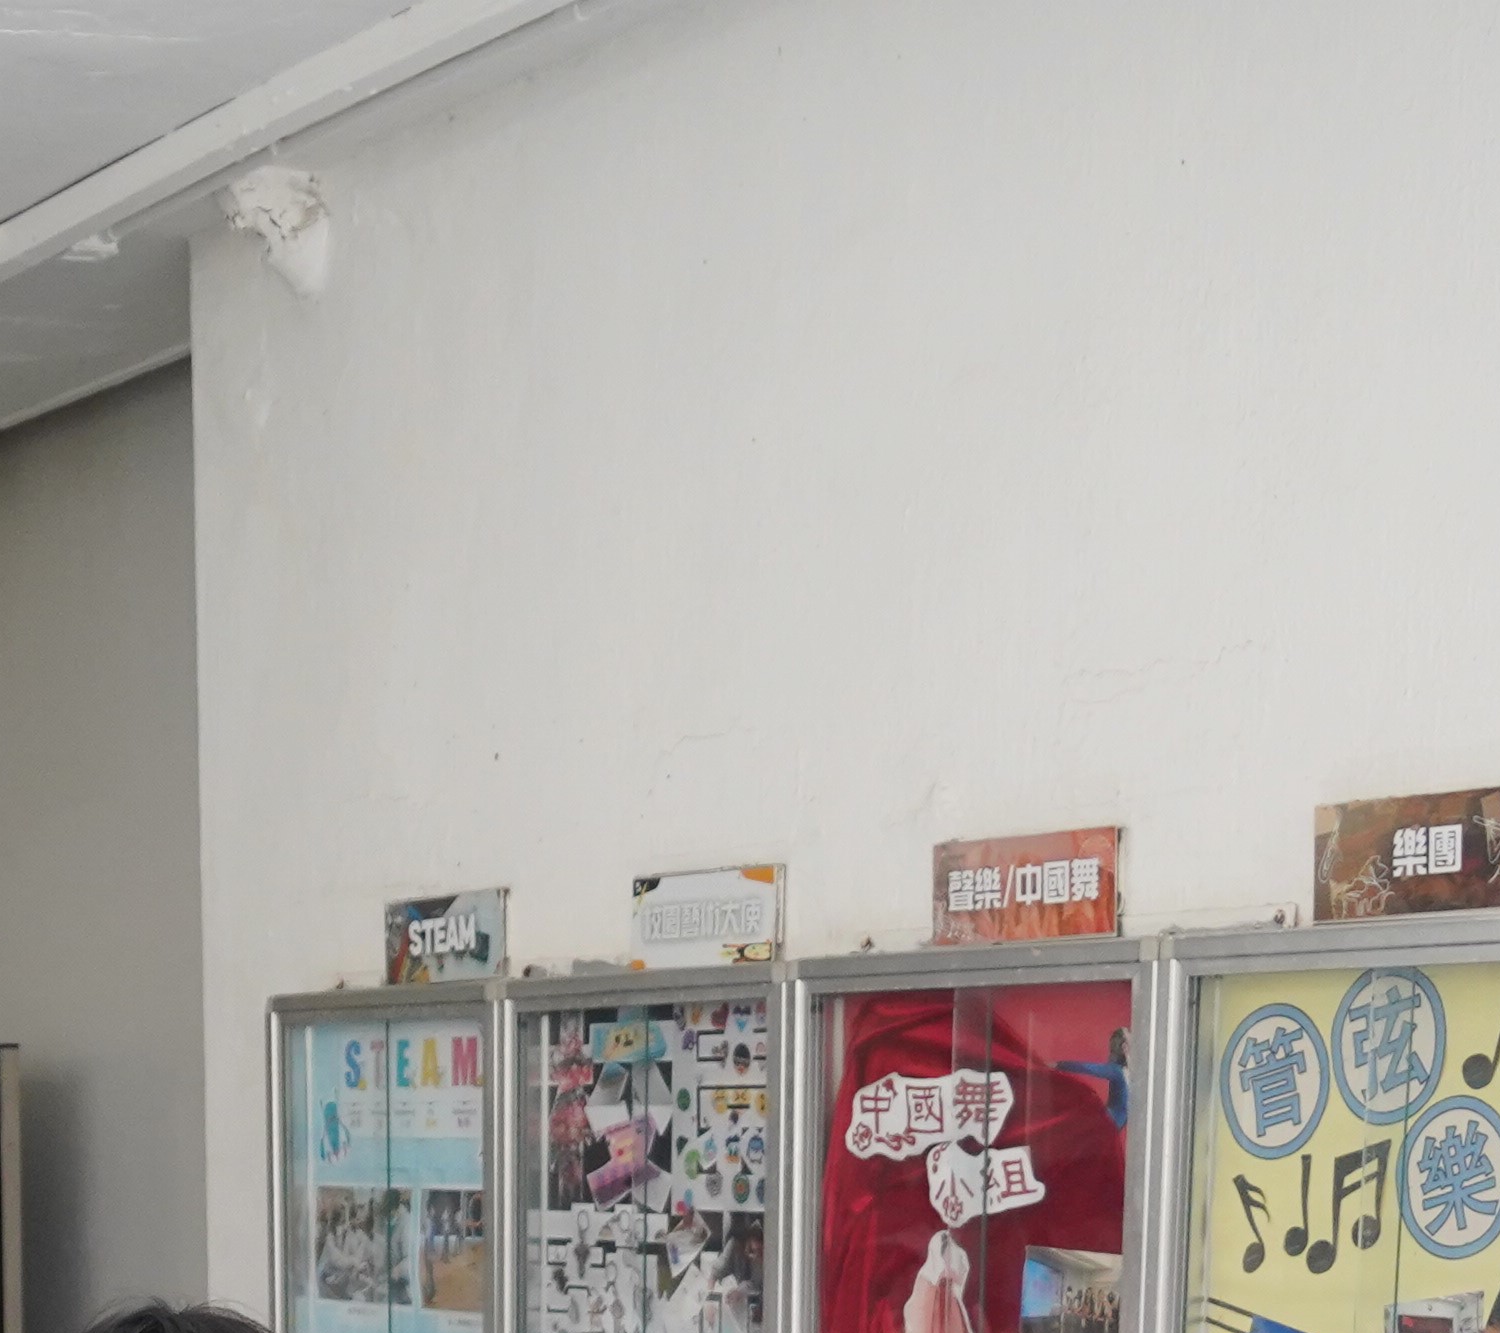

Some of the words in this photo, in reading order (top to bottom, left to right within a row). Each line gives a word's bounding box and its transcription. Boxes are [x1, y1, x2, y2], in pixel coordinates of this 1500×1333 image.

[1392, 814, 1462, 878] 樂團
[948, 857, 1100, 911] 聲樂/中國舞
[408, 912, 476, 957] STEAM
[860, 1077, 1008, 1138] 中國舞
